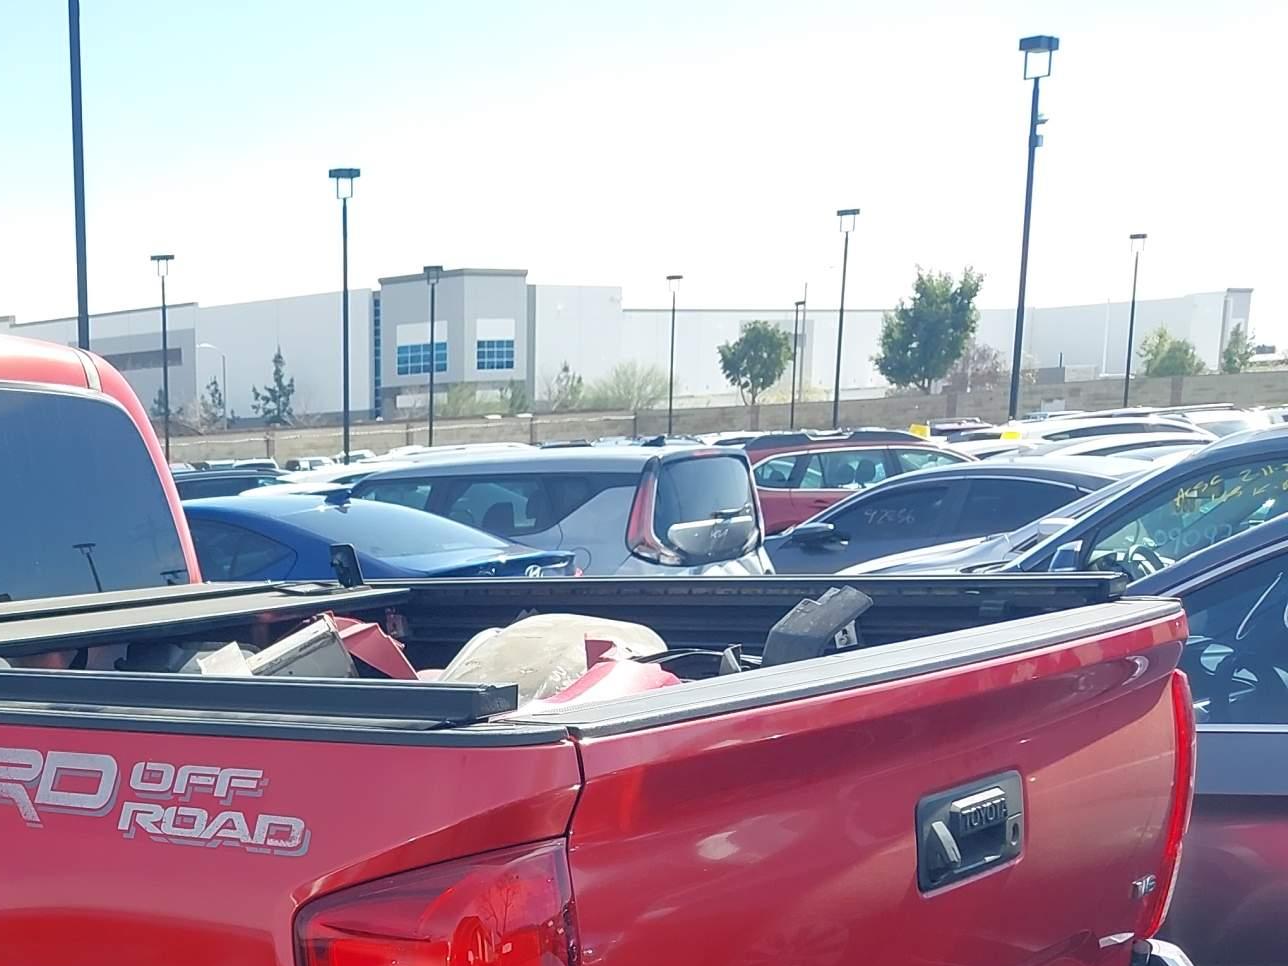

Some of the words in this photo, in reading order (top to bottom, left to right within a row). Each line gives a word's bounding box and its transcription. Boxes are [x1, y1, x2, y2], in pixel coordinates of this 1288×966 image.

[129, 760, 268, 805] OFF
[117, 801, 311, 856] ROAD
[961, 797, 1008, 831] TOYOTA
